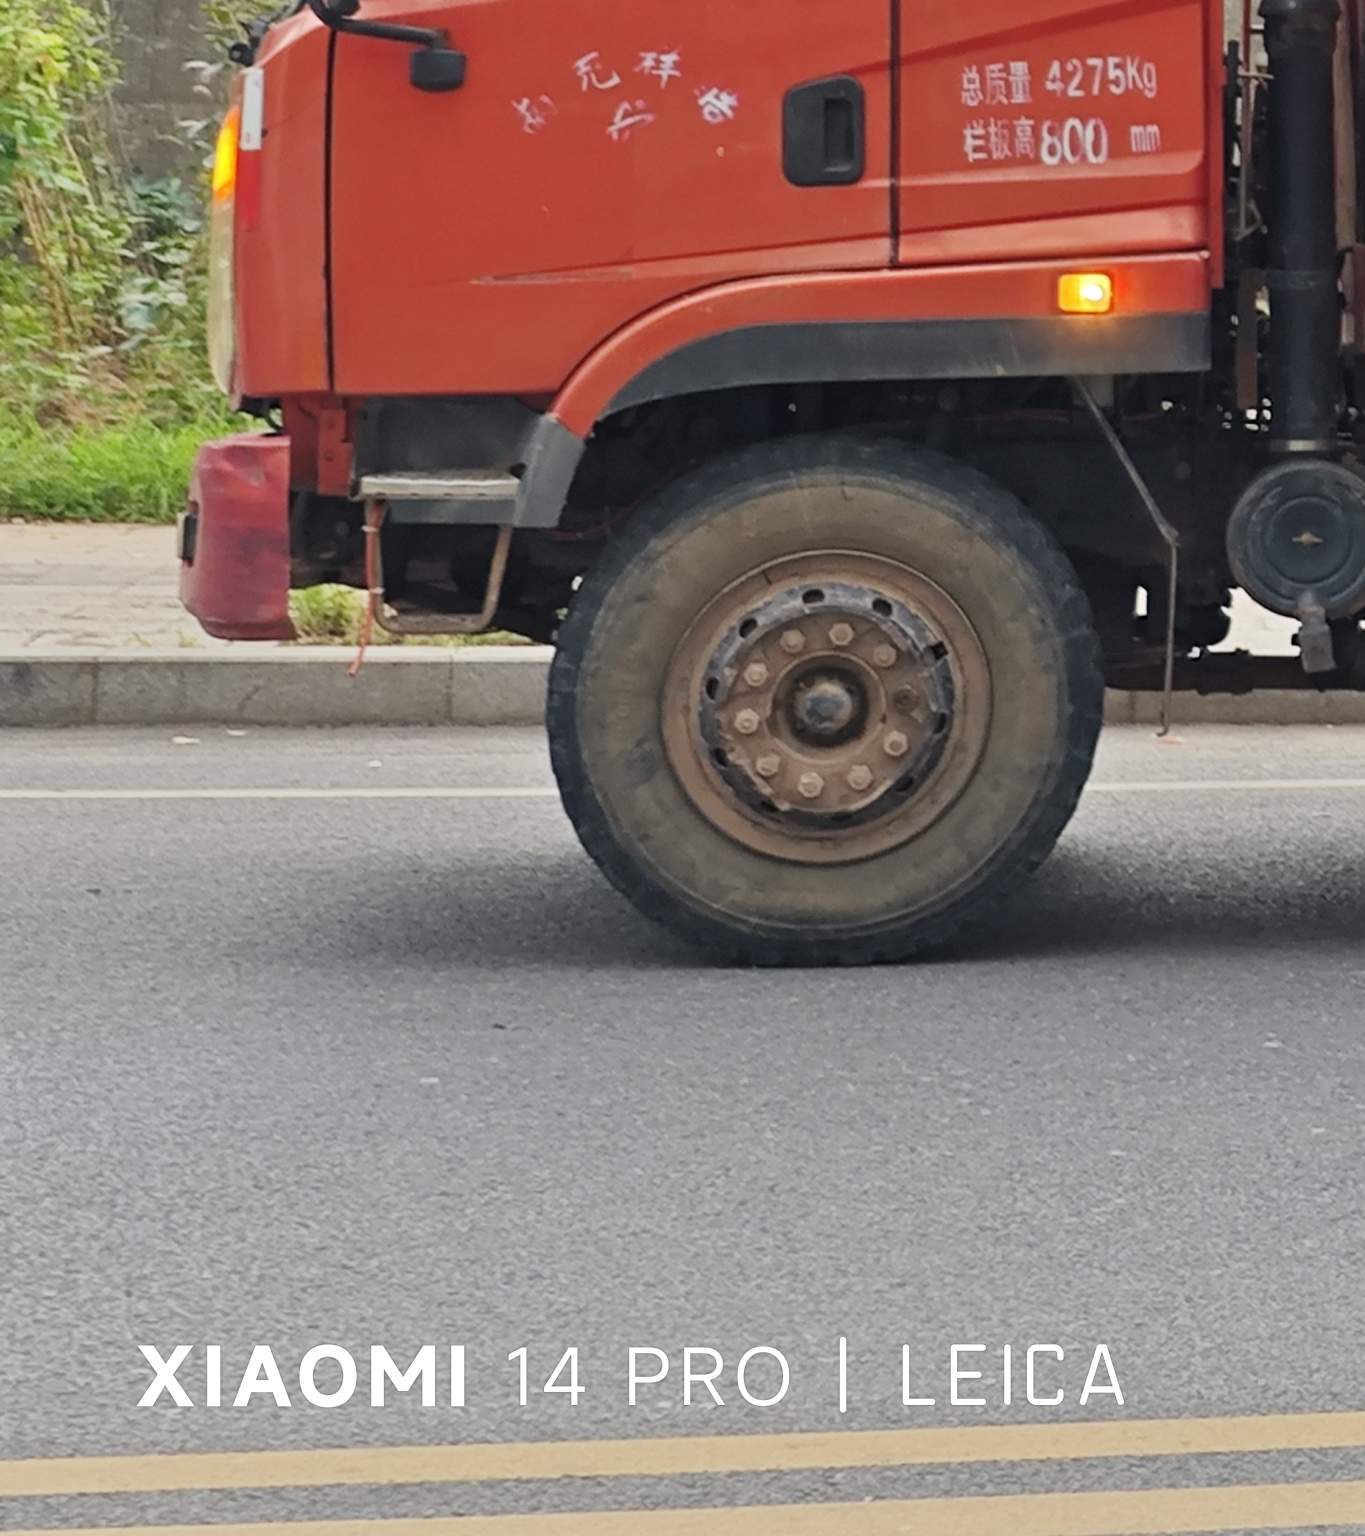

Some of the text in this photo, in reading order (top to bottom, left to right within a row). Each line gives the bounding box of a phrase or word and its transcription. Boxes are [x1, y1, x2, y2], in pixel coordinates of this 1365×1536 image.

[961, 61, 1032, 107] 总质量
[1130, 123, 1160, 152] mm
